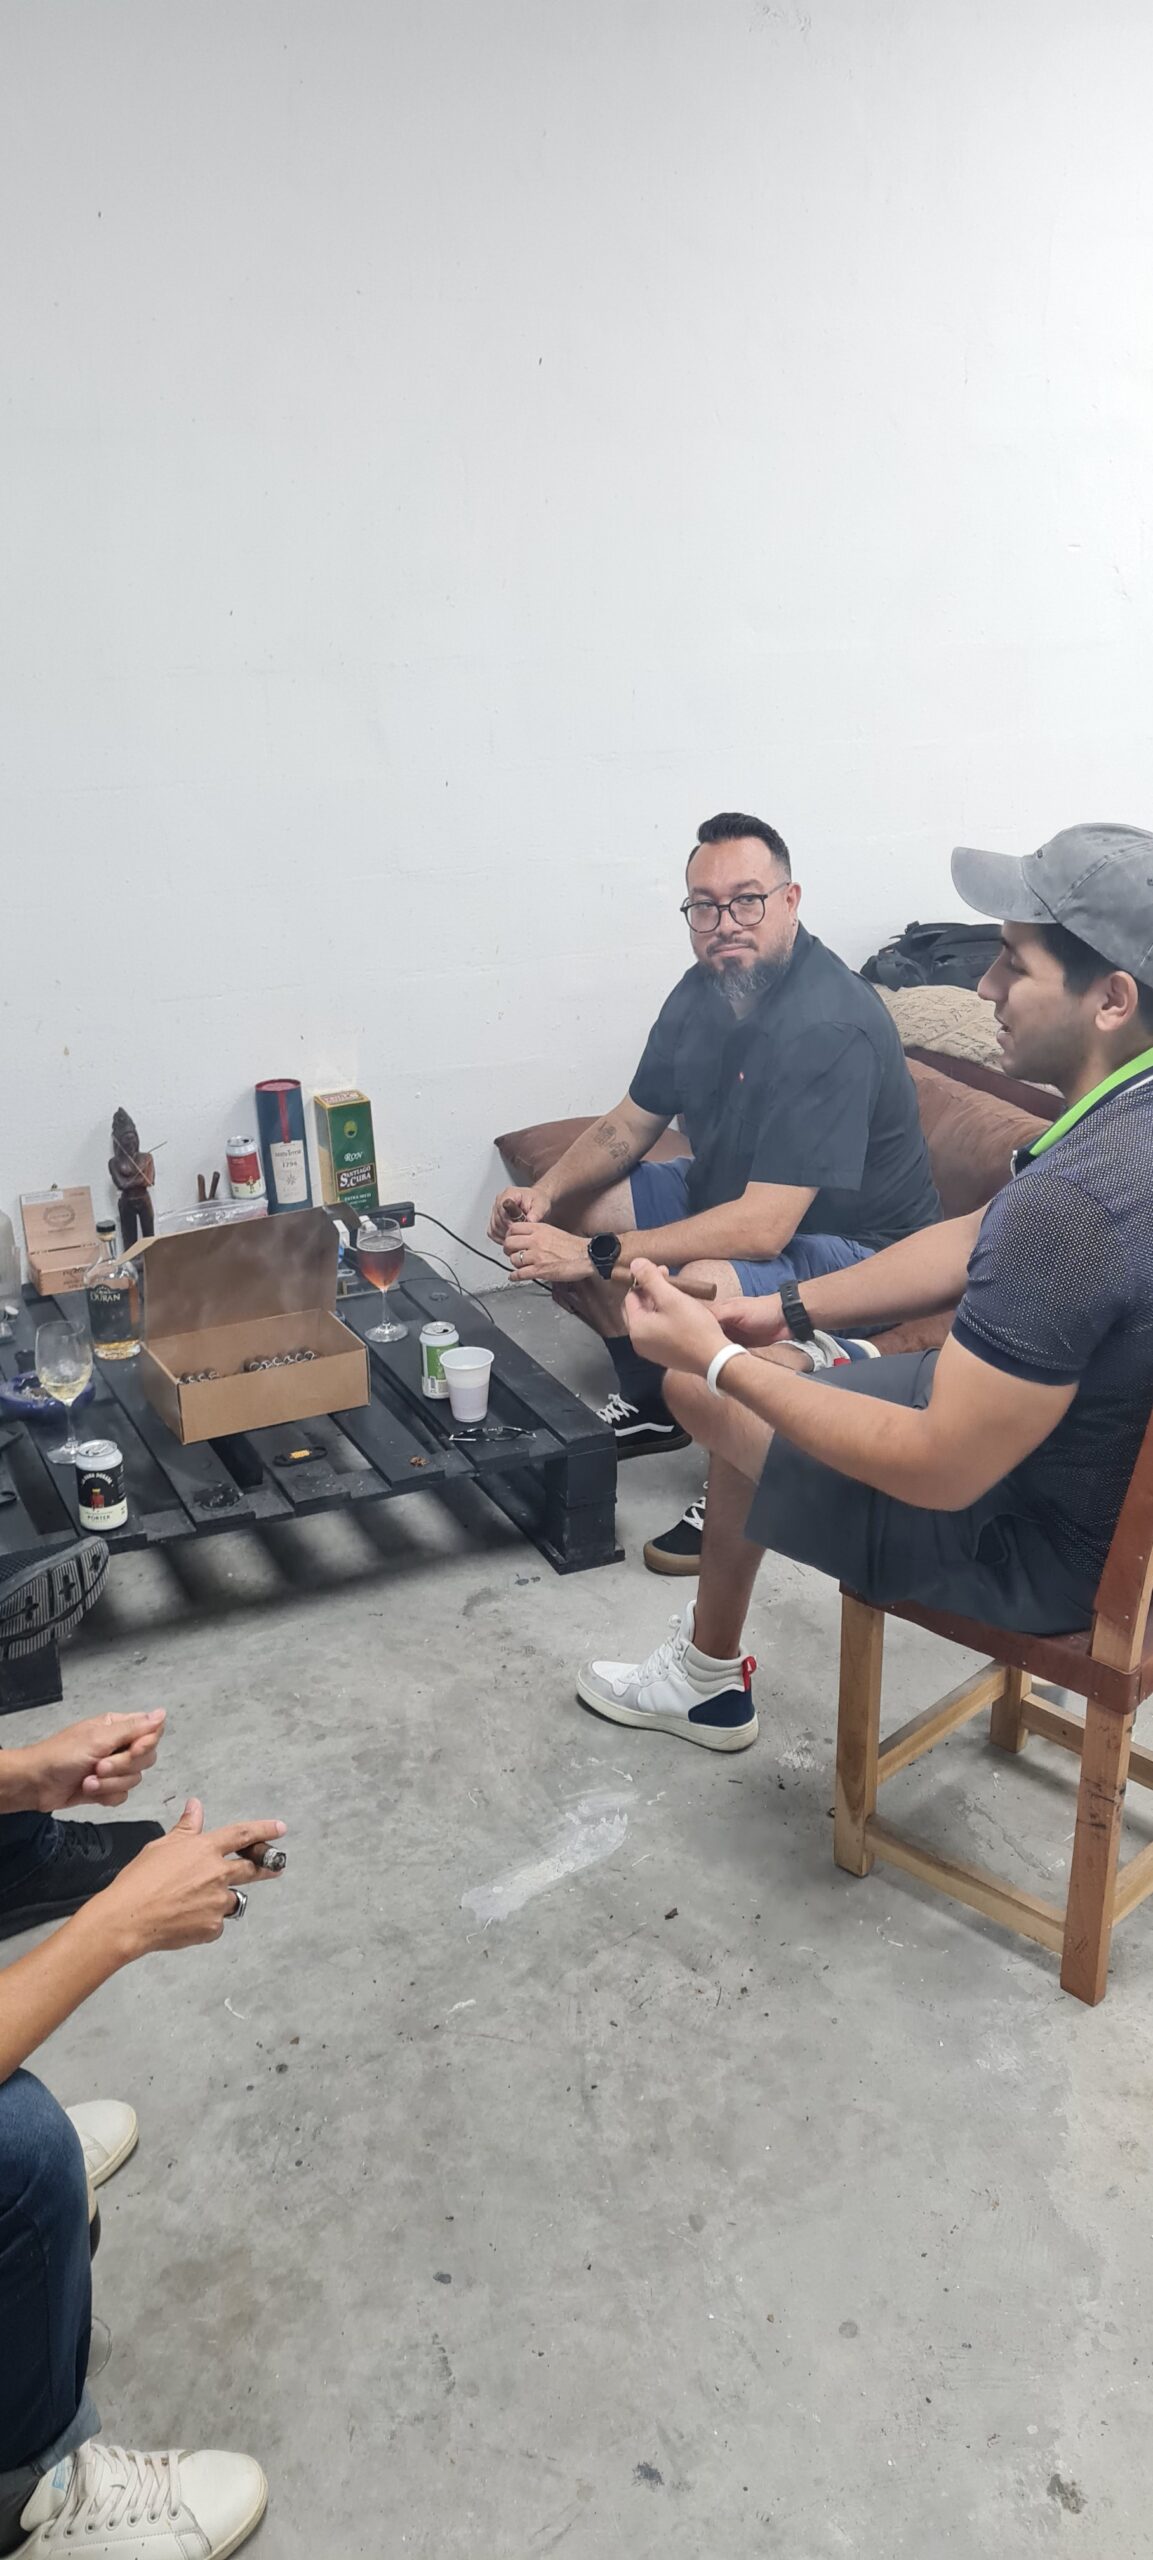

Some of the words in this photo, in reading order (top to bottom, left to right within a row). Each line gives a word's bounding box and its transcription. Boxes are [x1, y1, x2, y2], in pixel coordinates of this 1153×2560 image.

[344, 1152, 363, 1162] RON
[340, 1165, 371, 1187] SANTIAGO
[351, 1172, 371, 1187] CUBA
